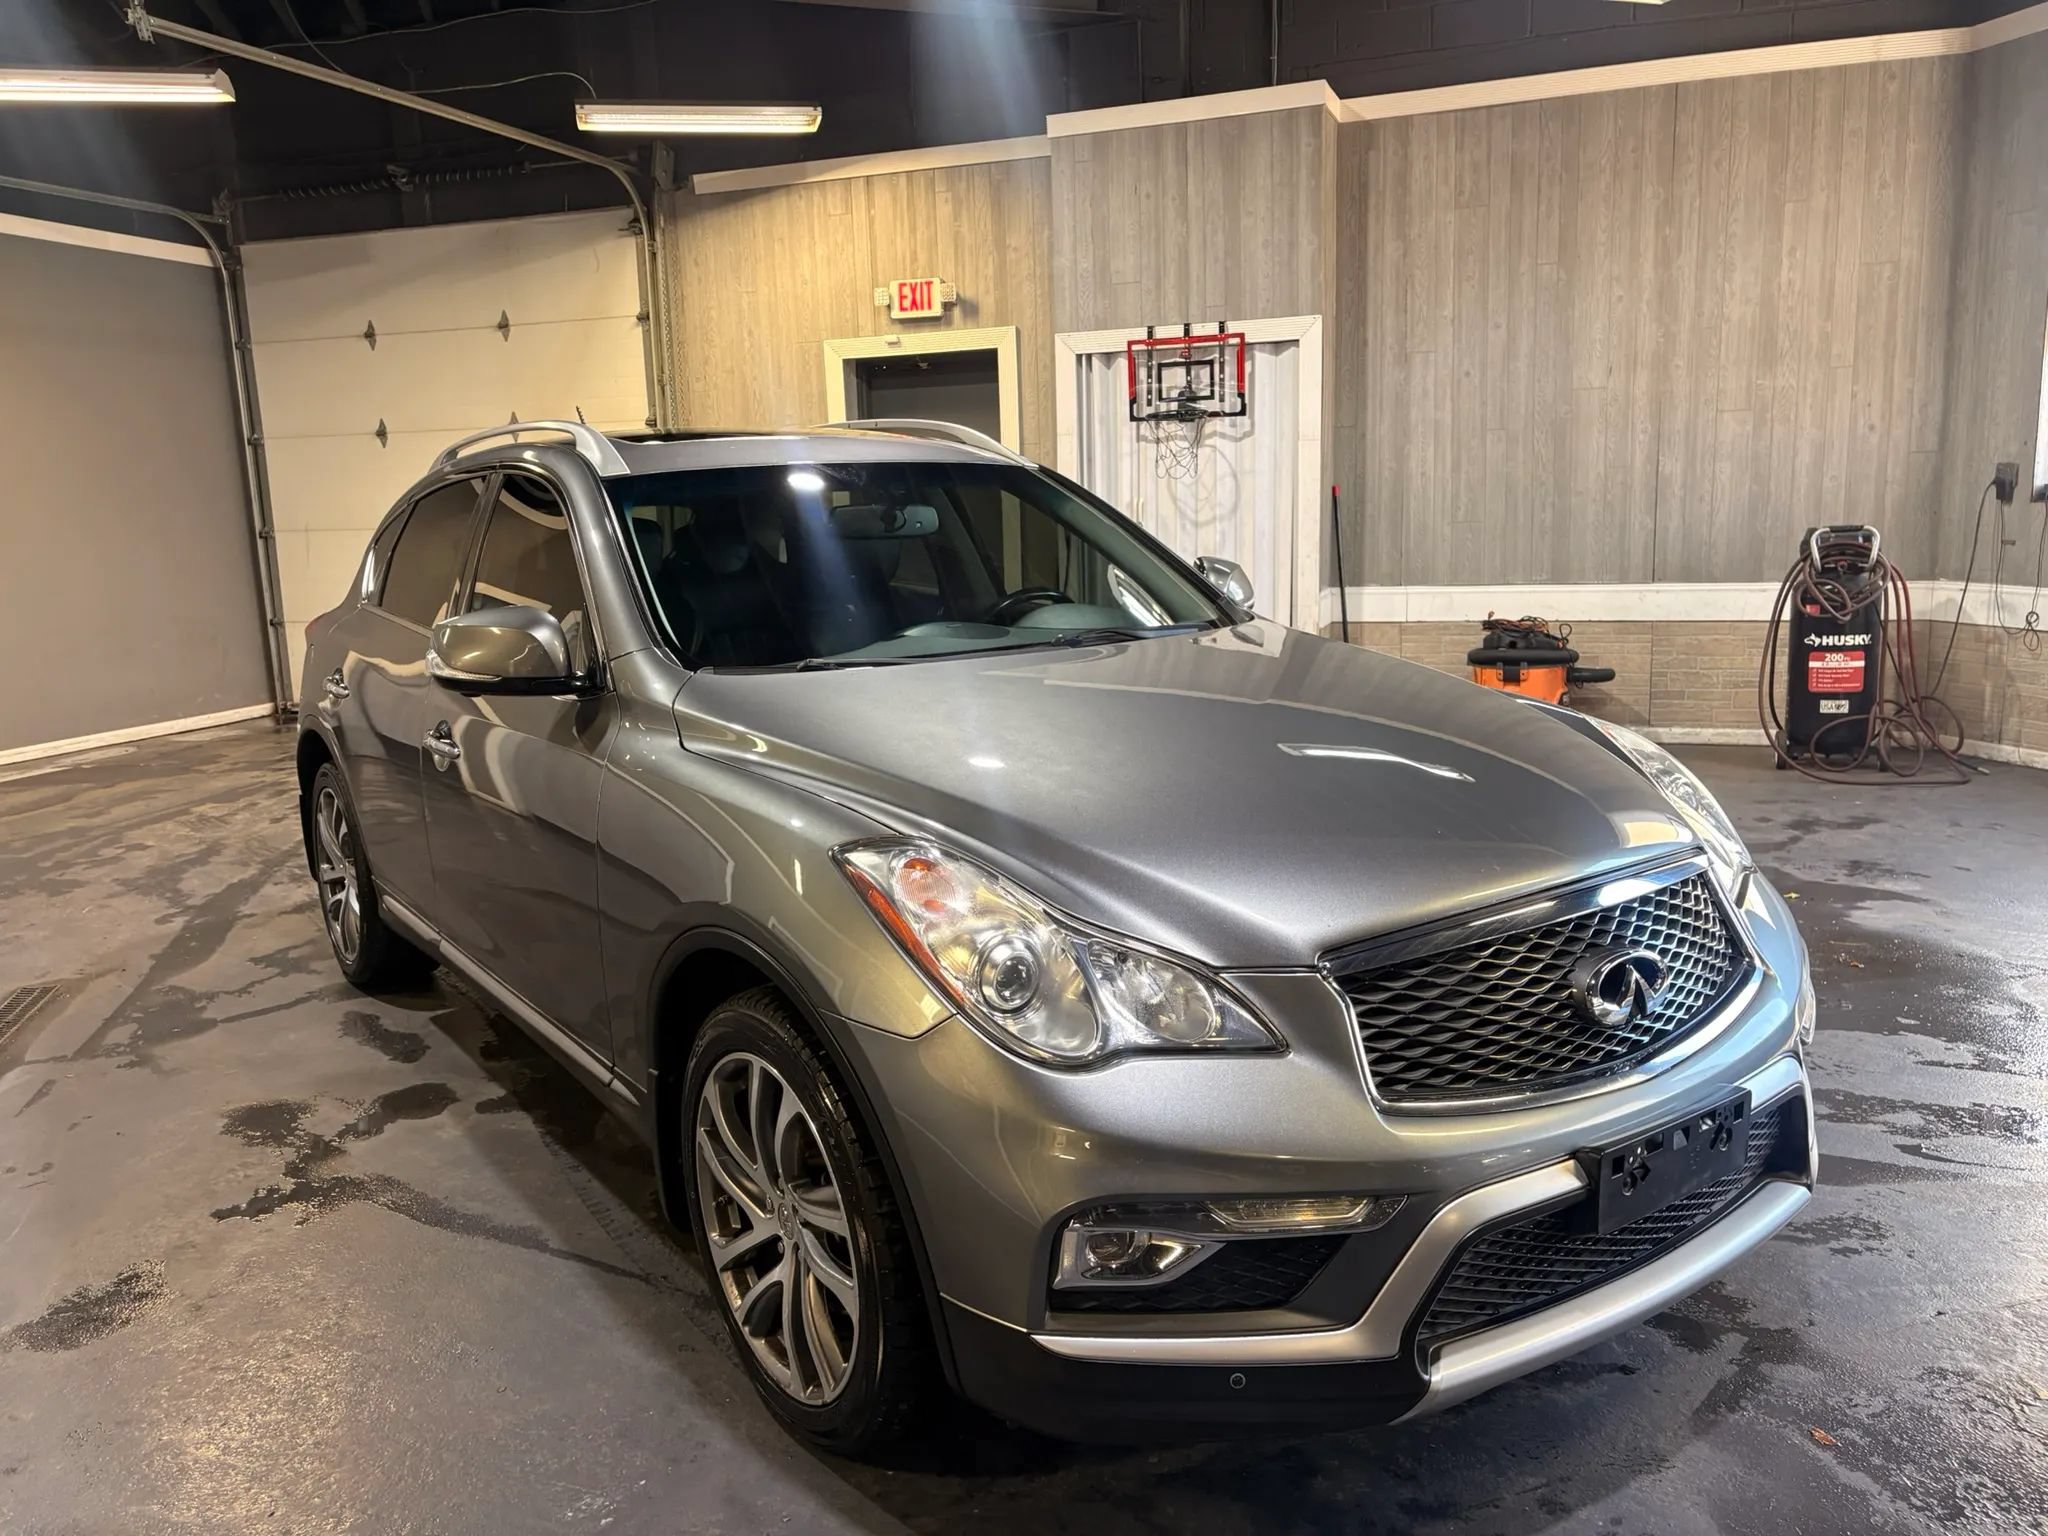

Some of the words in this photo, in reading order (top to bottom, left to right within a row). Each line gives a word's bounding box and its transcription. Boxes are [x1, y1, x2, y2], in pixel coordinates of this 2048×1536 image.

[898, 280, 933, 312] EXIT
[1822, 634, 1871, 646] HUSKY
[1824, 653, 1844, 662] 200
